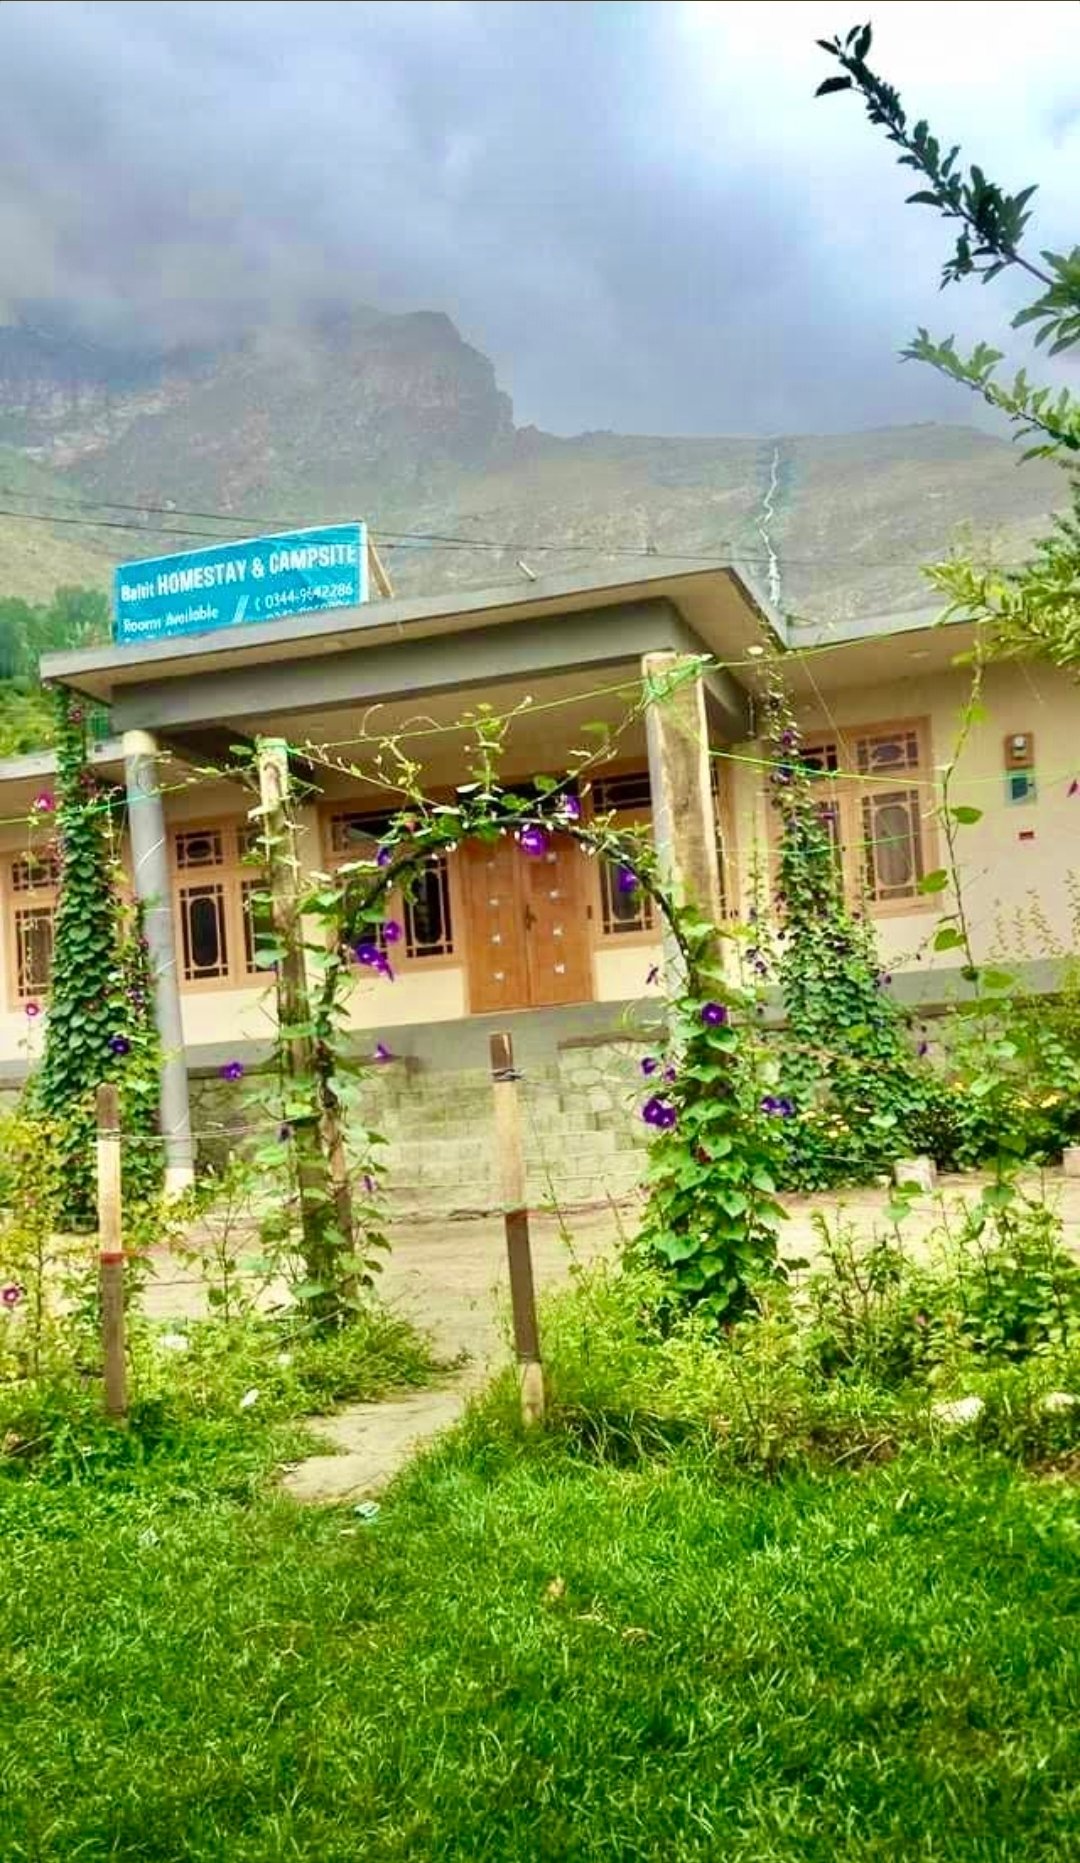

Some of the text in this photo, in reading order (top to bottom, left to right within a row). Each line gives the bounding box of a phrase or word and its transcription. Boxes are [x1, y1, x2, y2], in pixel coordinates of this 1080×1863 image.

[157, 559, 247, 596] HOMESTAY
[251, 557, 265, 579] &
[269, 544, 358, 574] CAMPSITE
